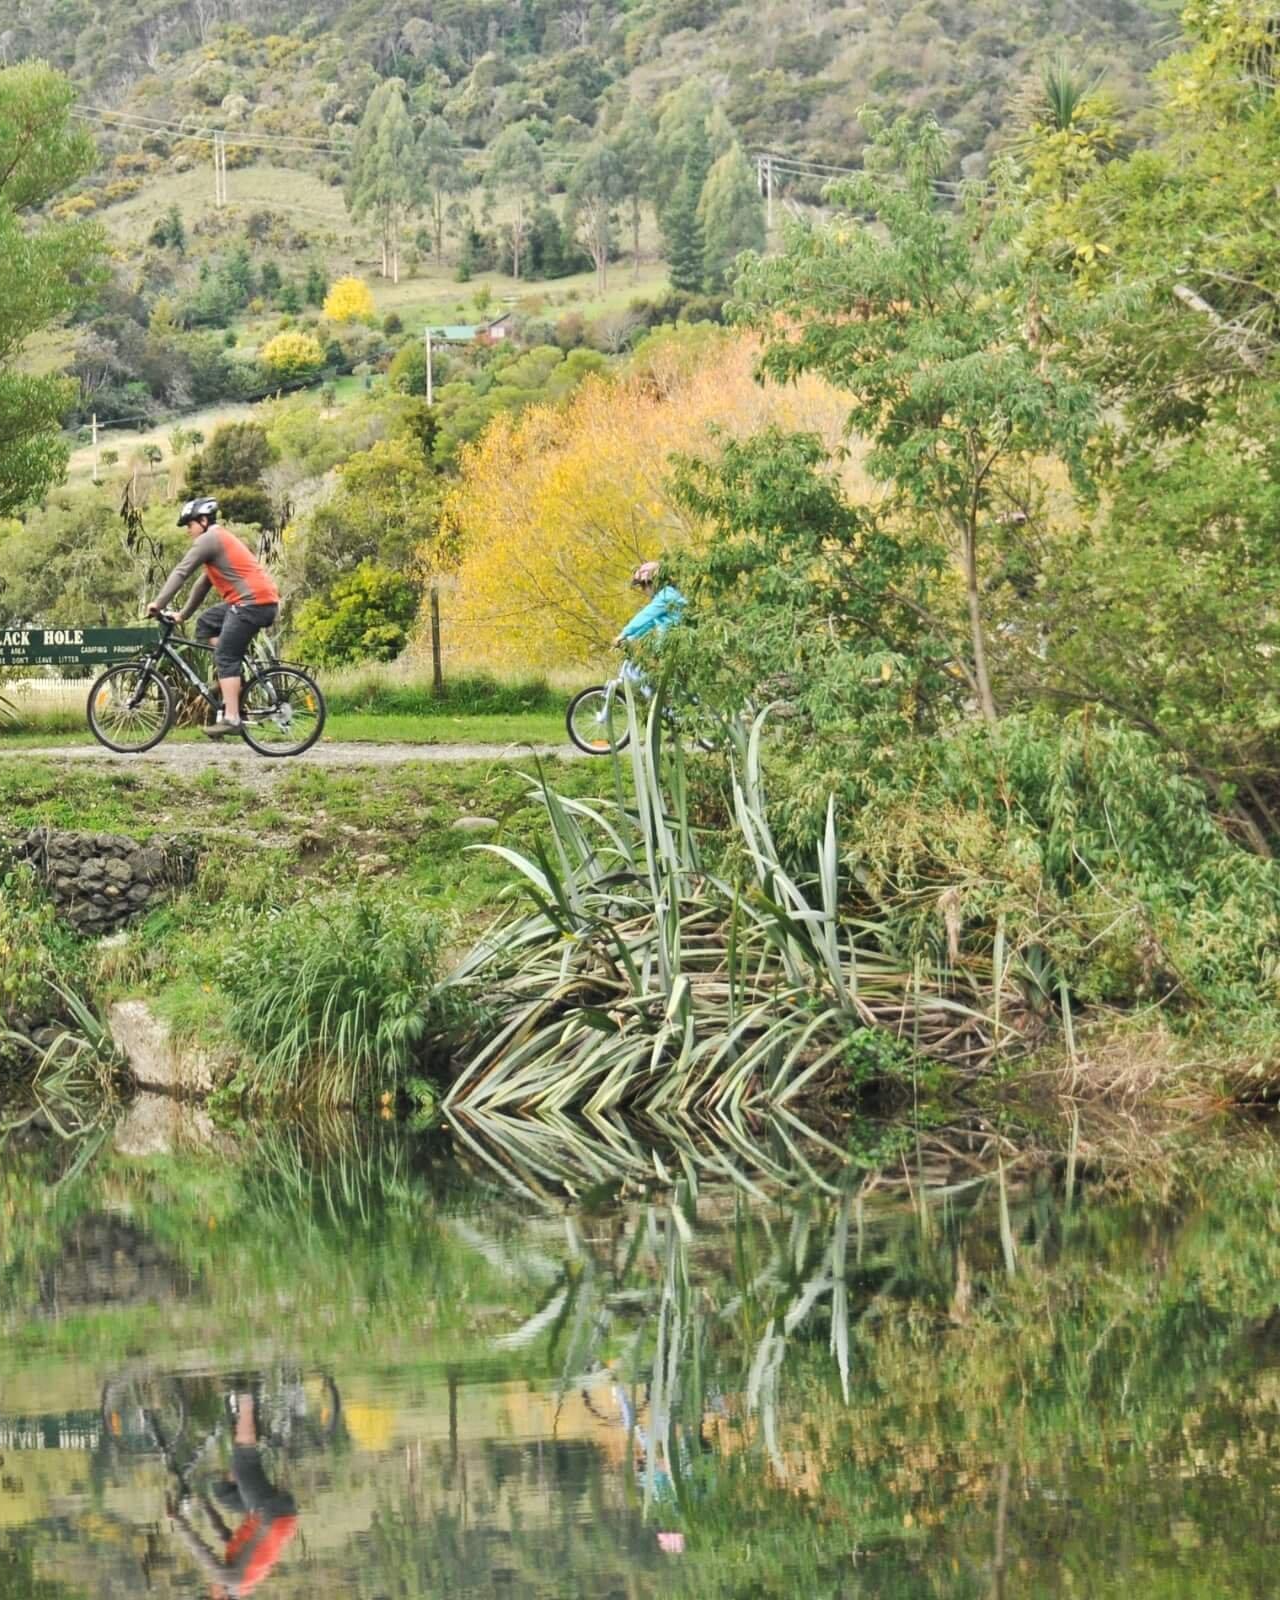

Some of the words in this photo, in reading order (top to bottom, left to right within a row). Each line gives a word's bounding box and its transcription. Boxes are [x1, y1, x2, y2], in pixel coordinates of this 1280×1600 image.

[43, 630, 83, 645] HOLE
[10, 647, 26, 655] AREA
[80, 646, 108, 654] CAMPING
[12, 656, 29, 664] DON'T
[35, 656, 52, 664] LEAVE
[58, 655, 79, 663] LITTER
